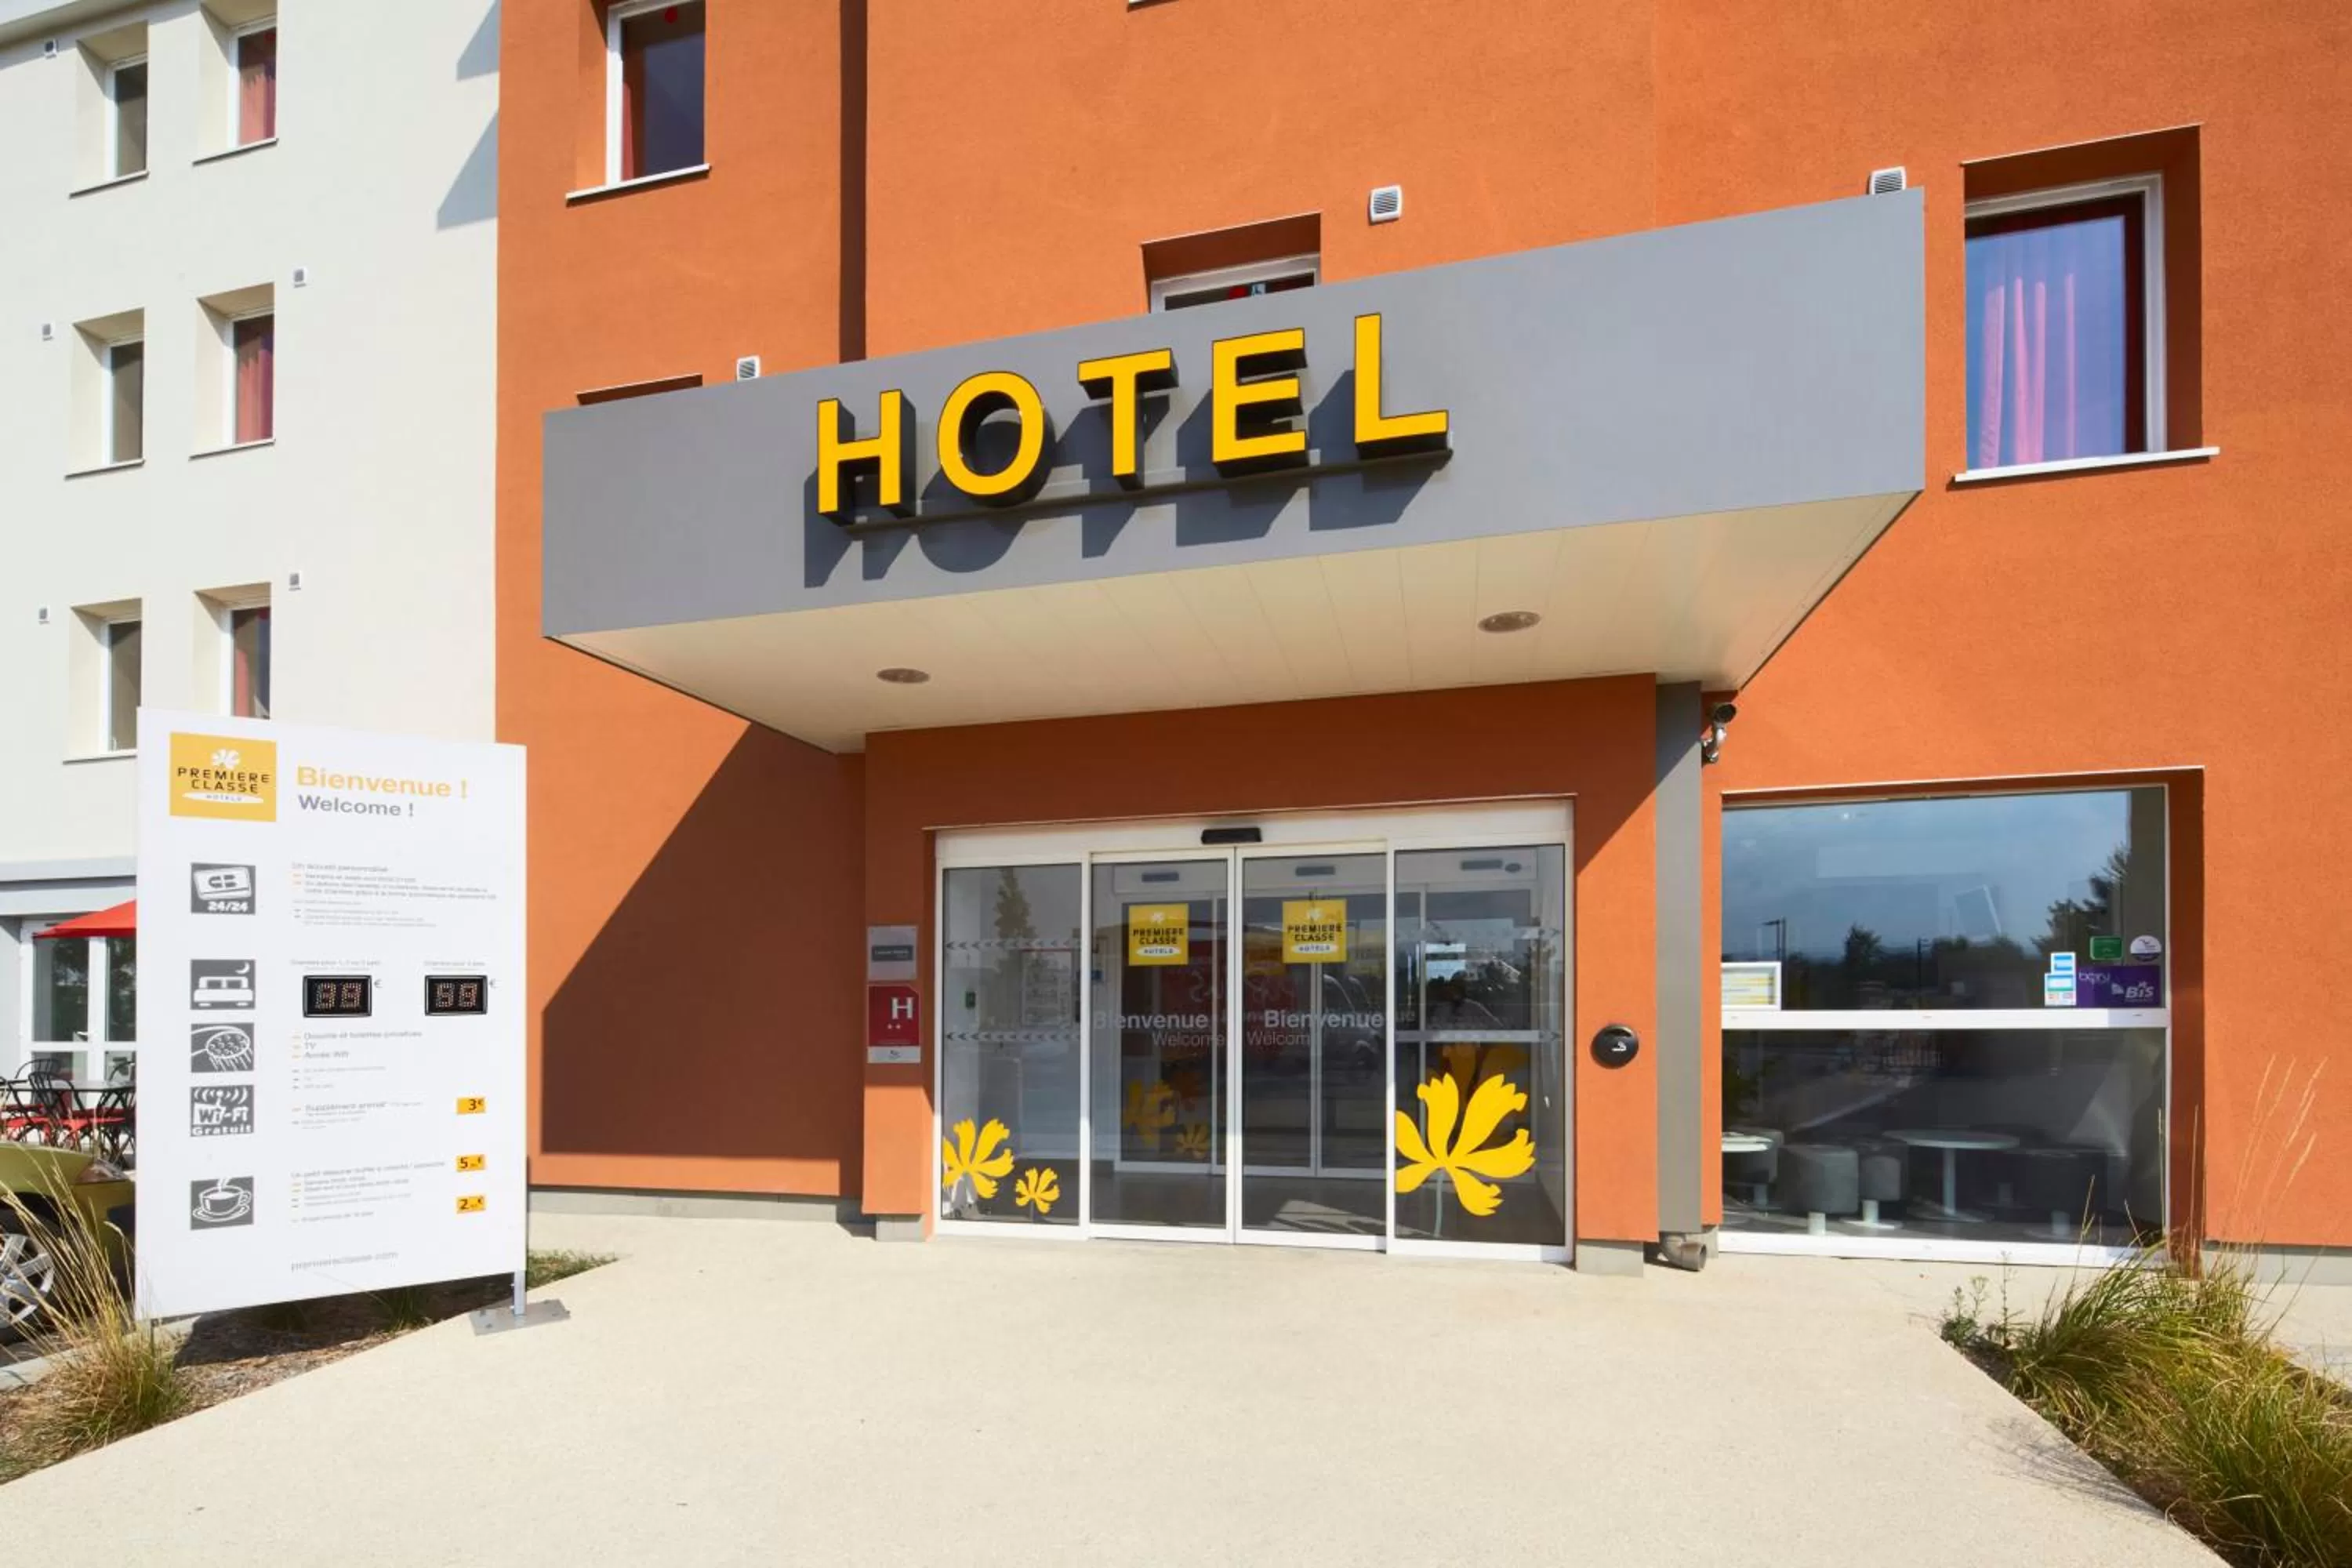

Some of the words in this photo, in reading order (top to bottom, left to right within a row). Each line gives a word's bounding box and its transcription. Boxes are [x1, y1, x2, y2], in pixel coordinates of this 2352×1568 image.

[817, 314, 1450, 516] HOTEL
[177, 767, 270, 783] PREMIERE
[297, 765, 452, 798] Bienvenue
[461, 779, 468, 799] !
[191, 779, 258, 793] CLASSE
[298, 793, 401, 816] Welcome
[408, 802, 414, 817] !
[208, 901, 249, 913] 24/24
[1133, 927, 1185, 937] PREMIERE
[1287, 924, 1342, 933] PREMIERE
[891, 997, 913, 1019] H
[1093, 1011, 1209, 1029] Bienvenue
[1263, 1009, 1385, 1028] Bienvenue
[1152, 1030, 1225, 1047] Welcome
[1247, 1030, 1312, 1047] Welcom
[192, 1123, 252, 1135] Gratuit
